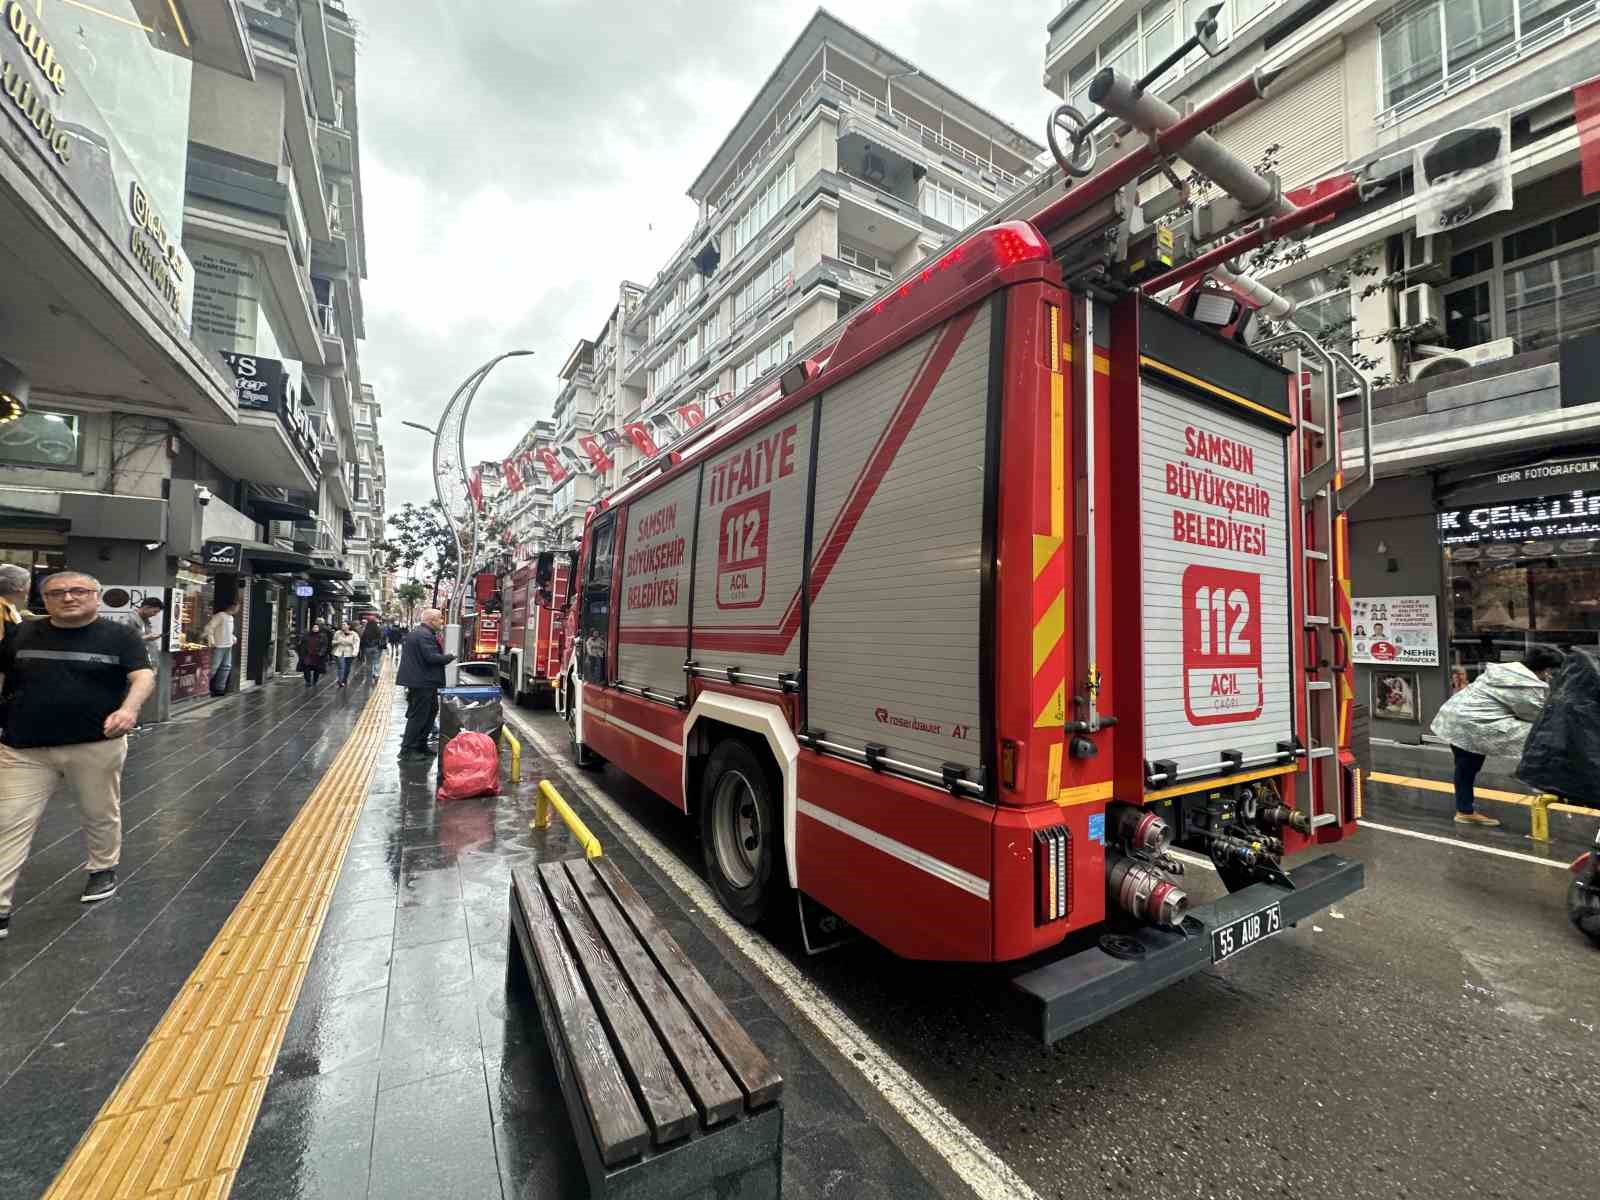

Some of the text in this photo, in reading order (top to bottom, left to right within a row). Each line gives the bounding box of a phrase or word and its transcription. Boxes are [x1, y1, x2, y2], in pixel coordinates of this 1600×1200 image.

[708, 424, 798, 506] İTFAİYE
[1184, 425, 1254, 475] SAMSUN
[1165, 460, 1270, 518] BÜYÜKŞEHİR
[638, 503, 677, 542] SAMSUN
[726, 509, 761, 563] 112
[1172, 509, 1266, 557] BELEDİYESİ
[626, 534, 686, 579] BÜYÜKŞEHİR
[627, 573, 679, 610] BELEDİYESİ
[1195, 585, 1251, 656] 112
[1379, 643, 1388, 654] 5
[951, 724, 970, 740] AT
[1219, 906, 1280, 956] 55 AUB 75
